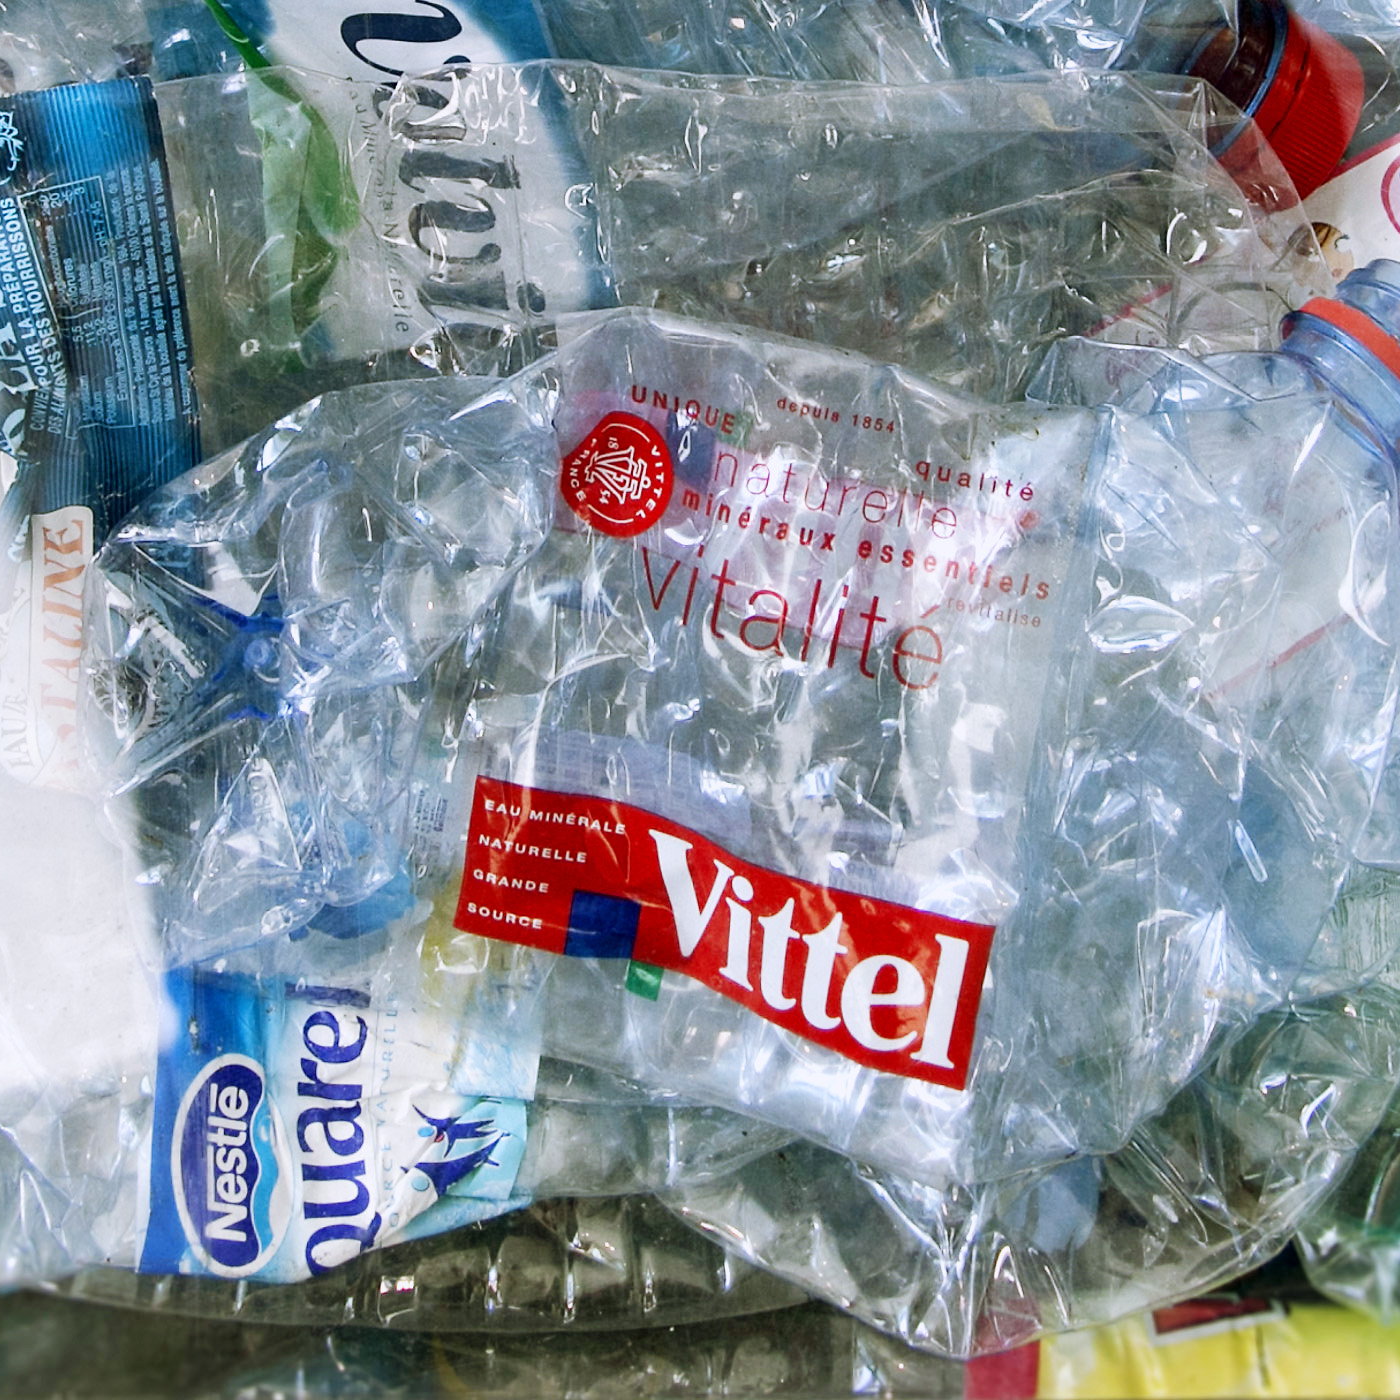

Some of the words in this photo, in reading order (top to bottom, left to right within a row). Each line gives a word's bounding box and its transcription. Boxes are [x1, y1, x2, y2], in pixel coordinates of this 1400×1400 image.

[2, 197, 48, 323] NOURRISSONS
[18, 316, 35, 338] LA
[34, 316, 56, 347] DES
[27, 344, 50, 388] POUR
[24, 384, 54, 431] CONVIEN
[46, 414, 66, 435] DES
[632, 385, 736, 436] UNIQUE
[777, 397, 841, 423] depuis
[852, 412, 896, 434] 1854
[636, 446, 664, 518] VITTEL
[712, 449, 958, 541] naturelle
[916, 457, 1035, 502] qualité
[682, 489, 835, 553] minéraux
[859, 541, 1050, 601] essentiels
[640, 546, 945, 691] vitalité
[484, 800, 520, 816] EAU
[530, 812, 625, 835] MINÉRALE
[479, 835, 586, 863] NATURELLE
[474, 869, 549, 893] GRANDE
[468, 902, 542, 929] SOURCE
[648, 829, 970, 1069] Vittel
[206, 1083, 253, 1241] Nestlé
